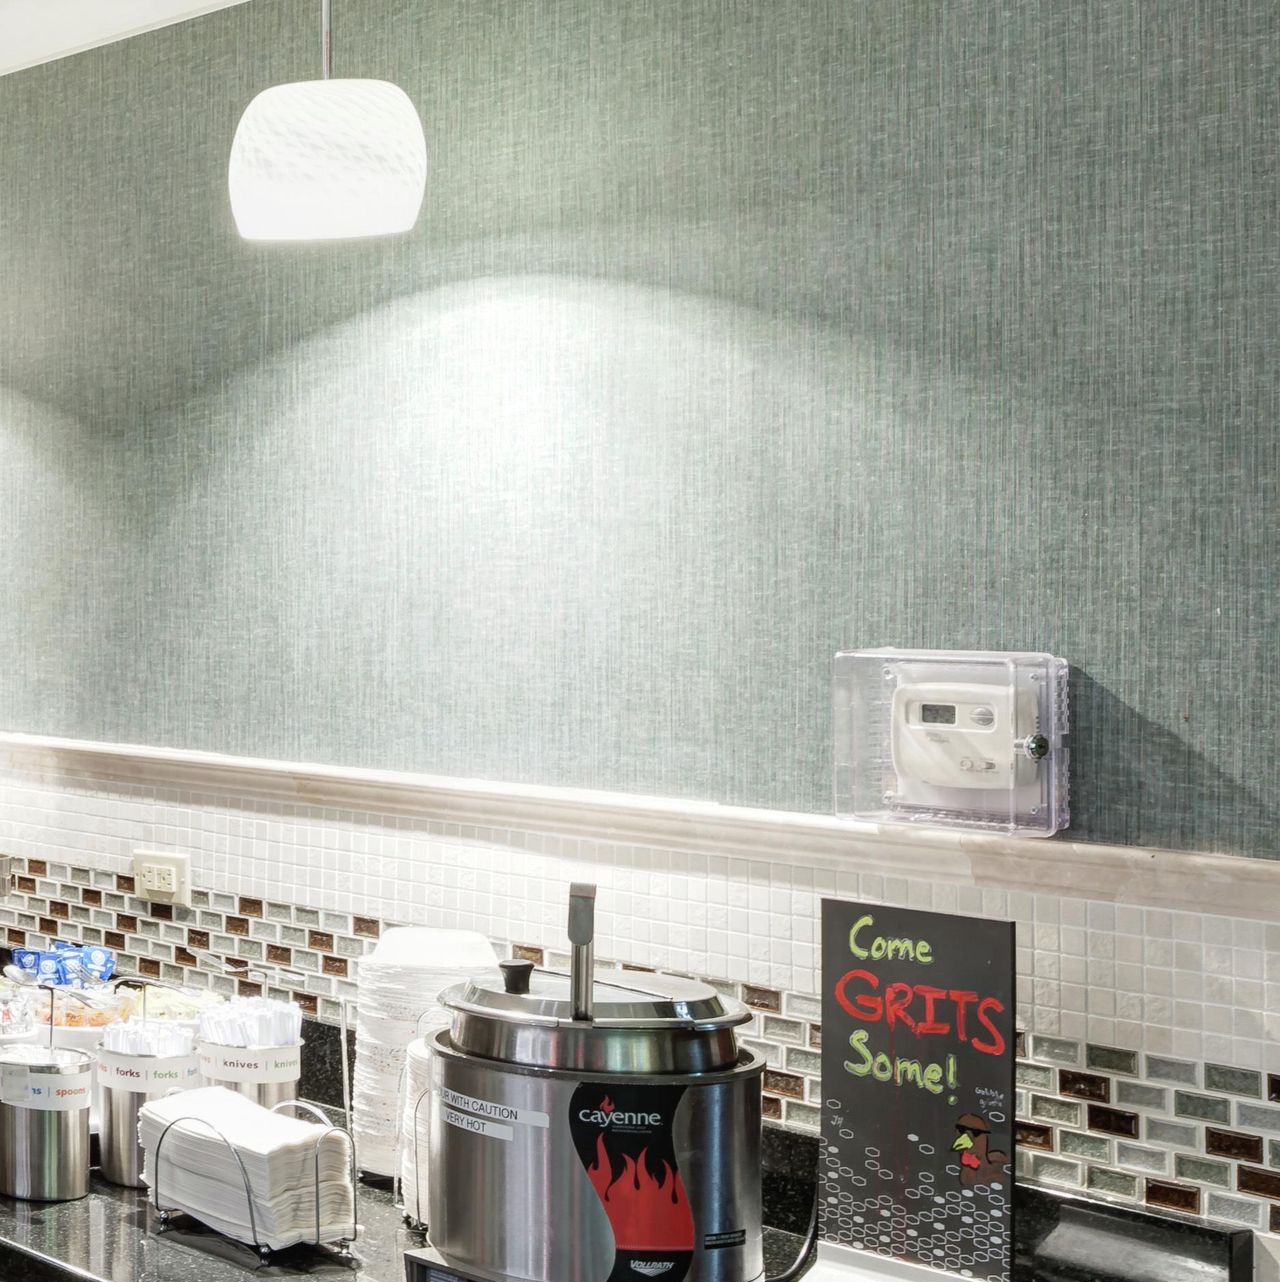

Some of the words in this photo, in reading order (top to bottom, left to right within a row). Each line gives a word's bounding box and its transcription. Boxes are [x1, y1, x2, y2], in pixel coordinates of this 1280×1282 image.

[848, 914, 934, 965] Come
[834, 968, 1006, 1056] GRITS
[116, 1066, 141, 1078] forks
[153, 1070, 178, 1079] forks
[844, 1029, 959, 1106] Some!
[450, 1092, 470, 1109] WITH
[471, 1101, 518, 1120] CAUTION
[579, 1109, 661, 1127] cayenne
[445, 1110, 465, 1124] VERY
[466, 1118, 487, 1132] HOT
[630, 1260, 675, 1269] VOLLRATH
